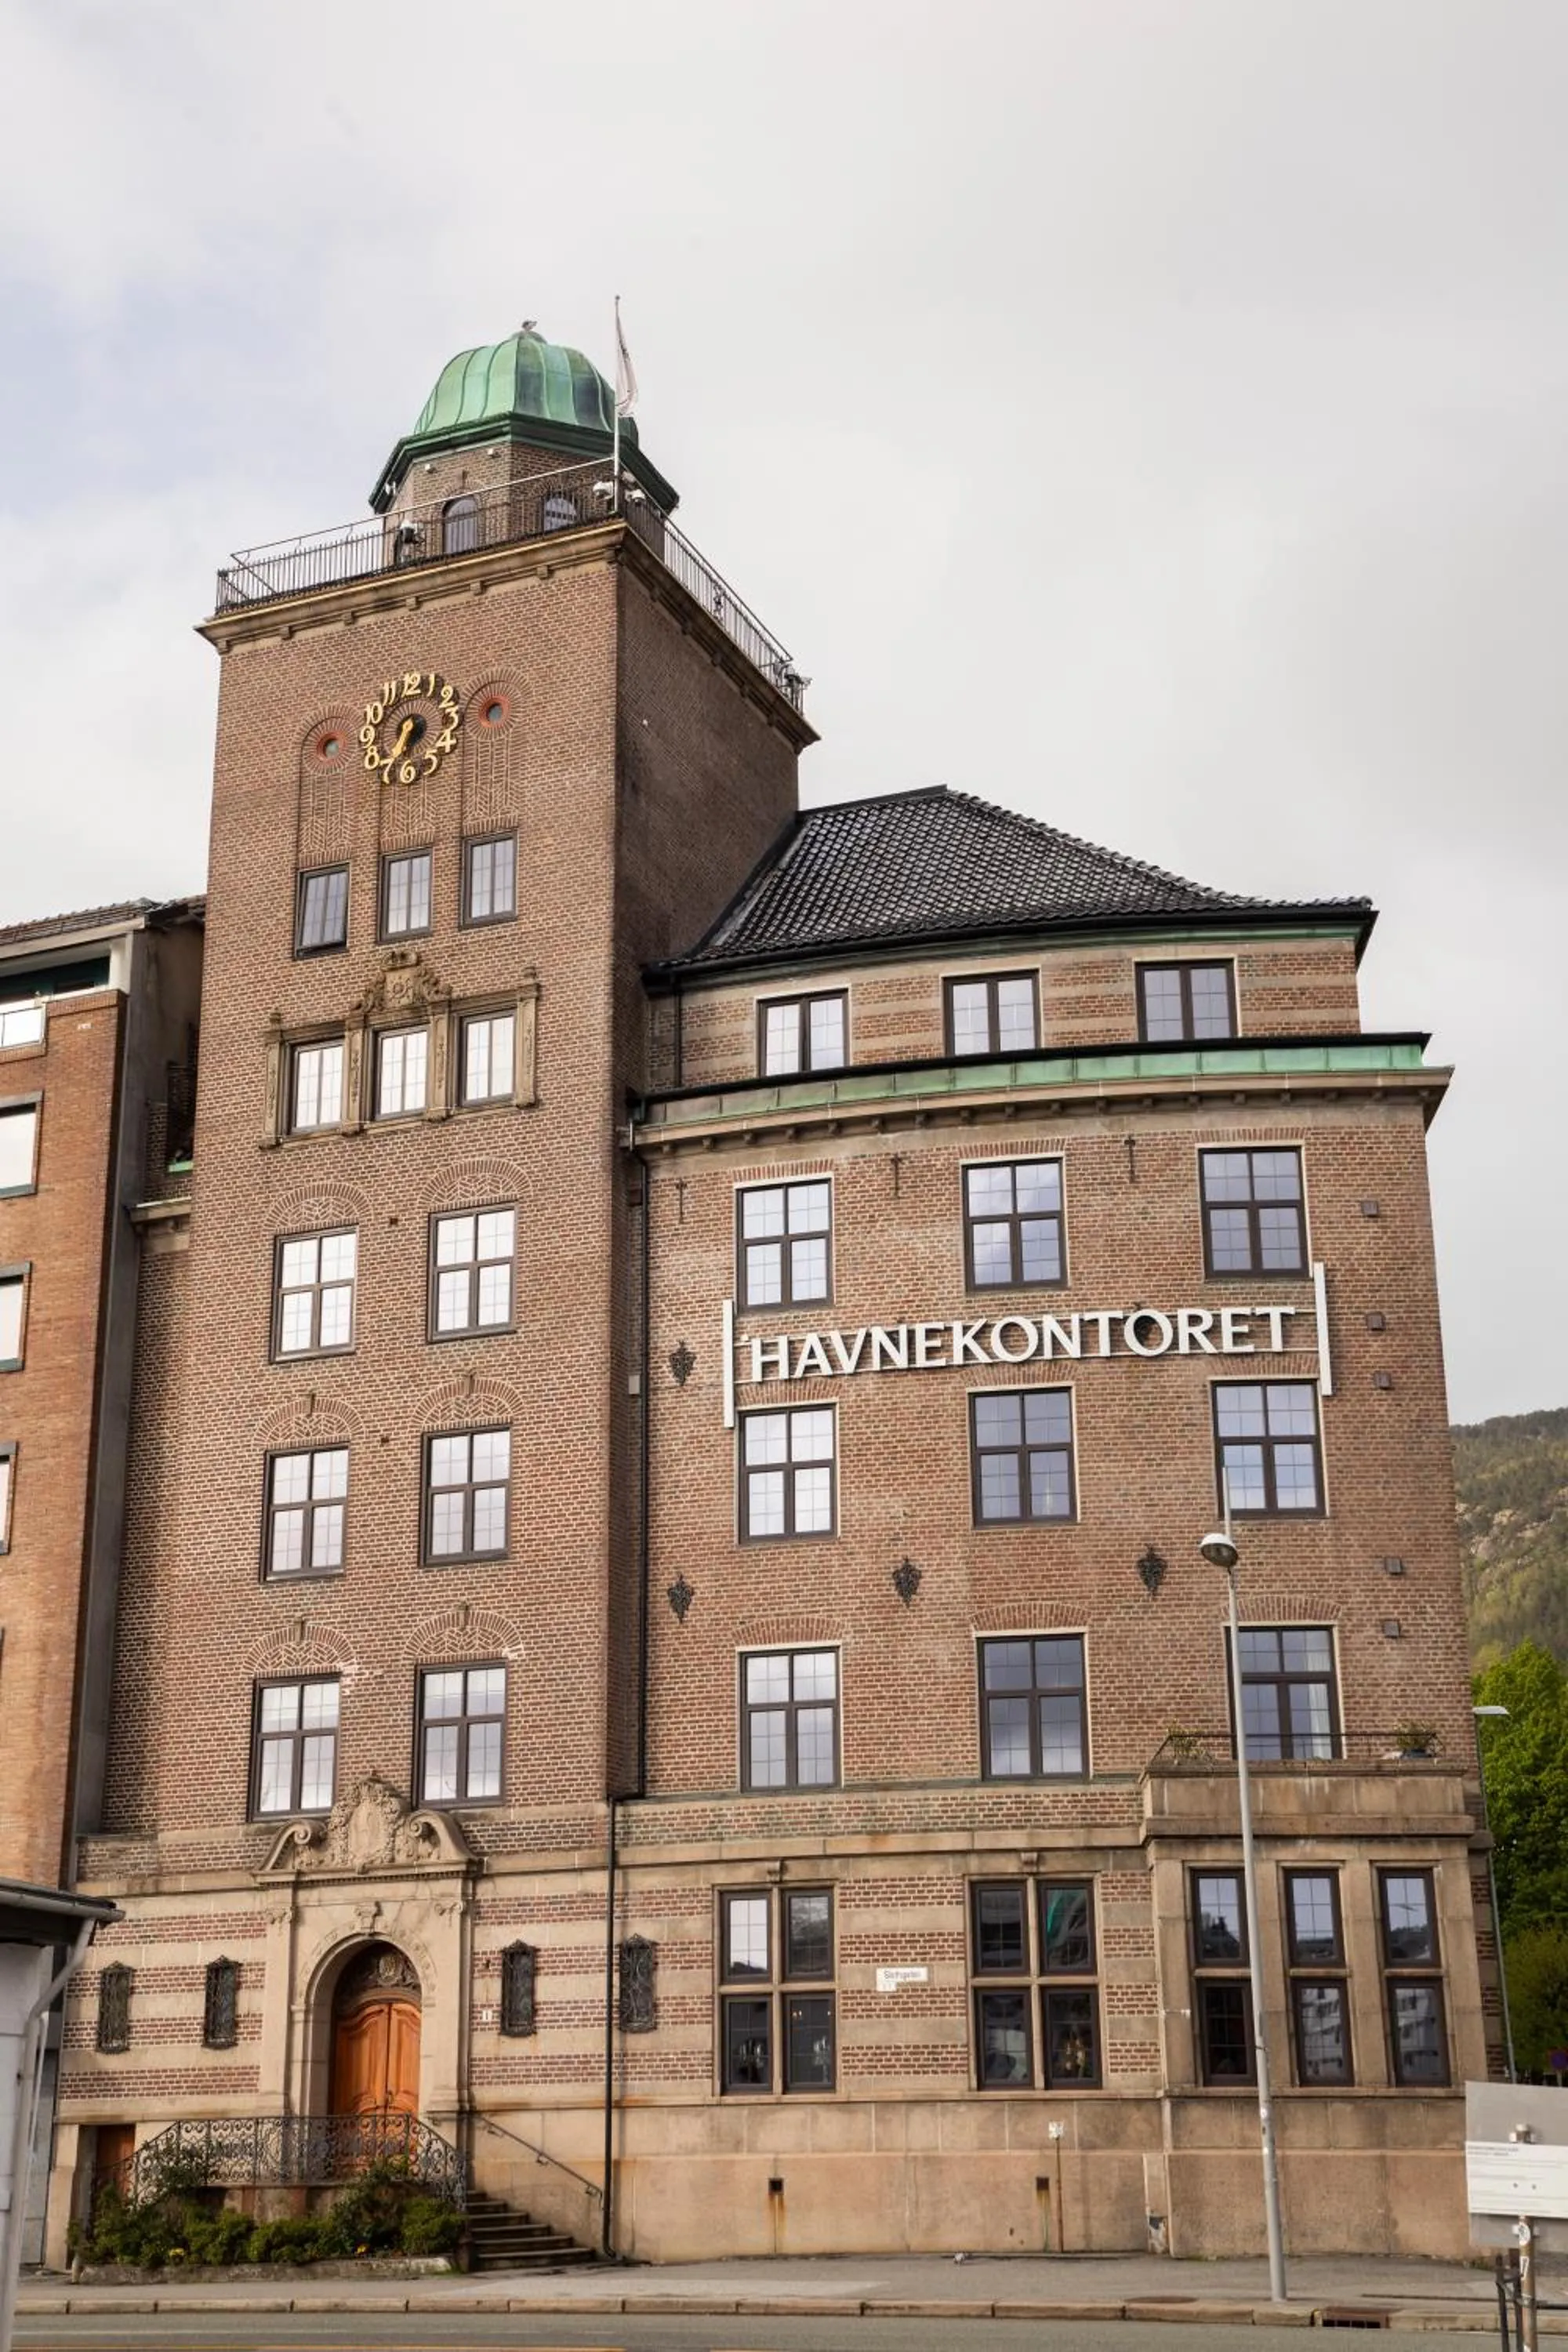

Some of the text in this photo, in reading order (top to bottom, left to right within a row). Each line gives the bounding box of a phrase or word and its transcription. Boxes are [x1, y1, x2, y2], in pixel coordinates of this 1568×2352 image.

[382, 681, 397, 706] 11
[401, 671, 421, 697] 12
[426, 673, 435, 697] 1
[439, 684, 455, 708] 2
[365, 702, 383, 724] 10
[445, 705, 459, 730] 3
[360, 724, 376, 749] 9
[436, 728, 457, 753] 4
[364, 745, 380, 770] 8
[423, 750, 437, 775] 5
[379, 757, 394, 784] 7
[399, 760, 416, 783] 6
[751, 1306, 1296, 1382] HAVNEKONTORET
